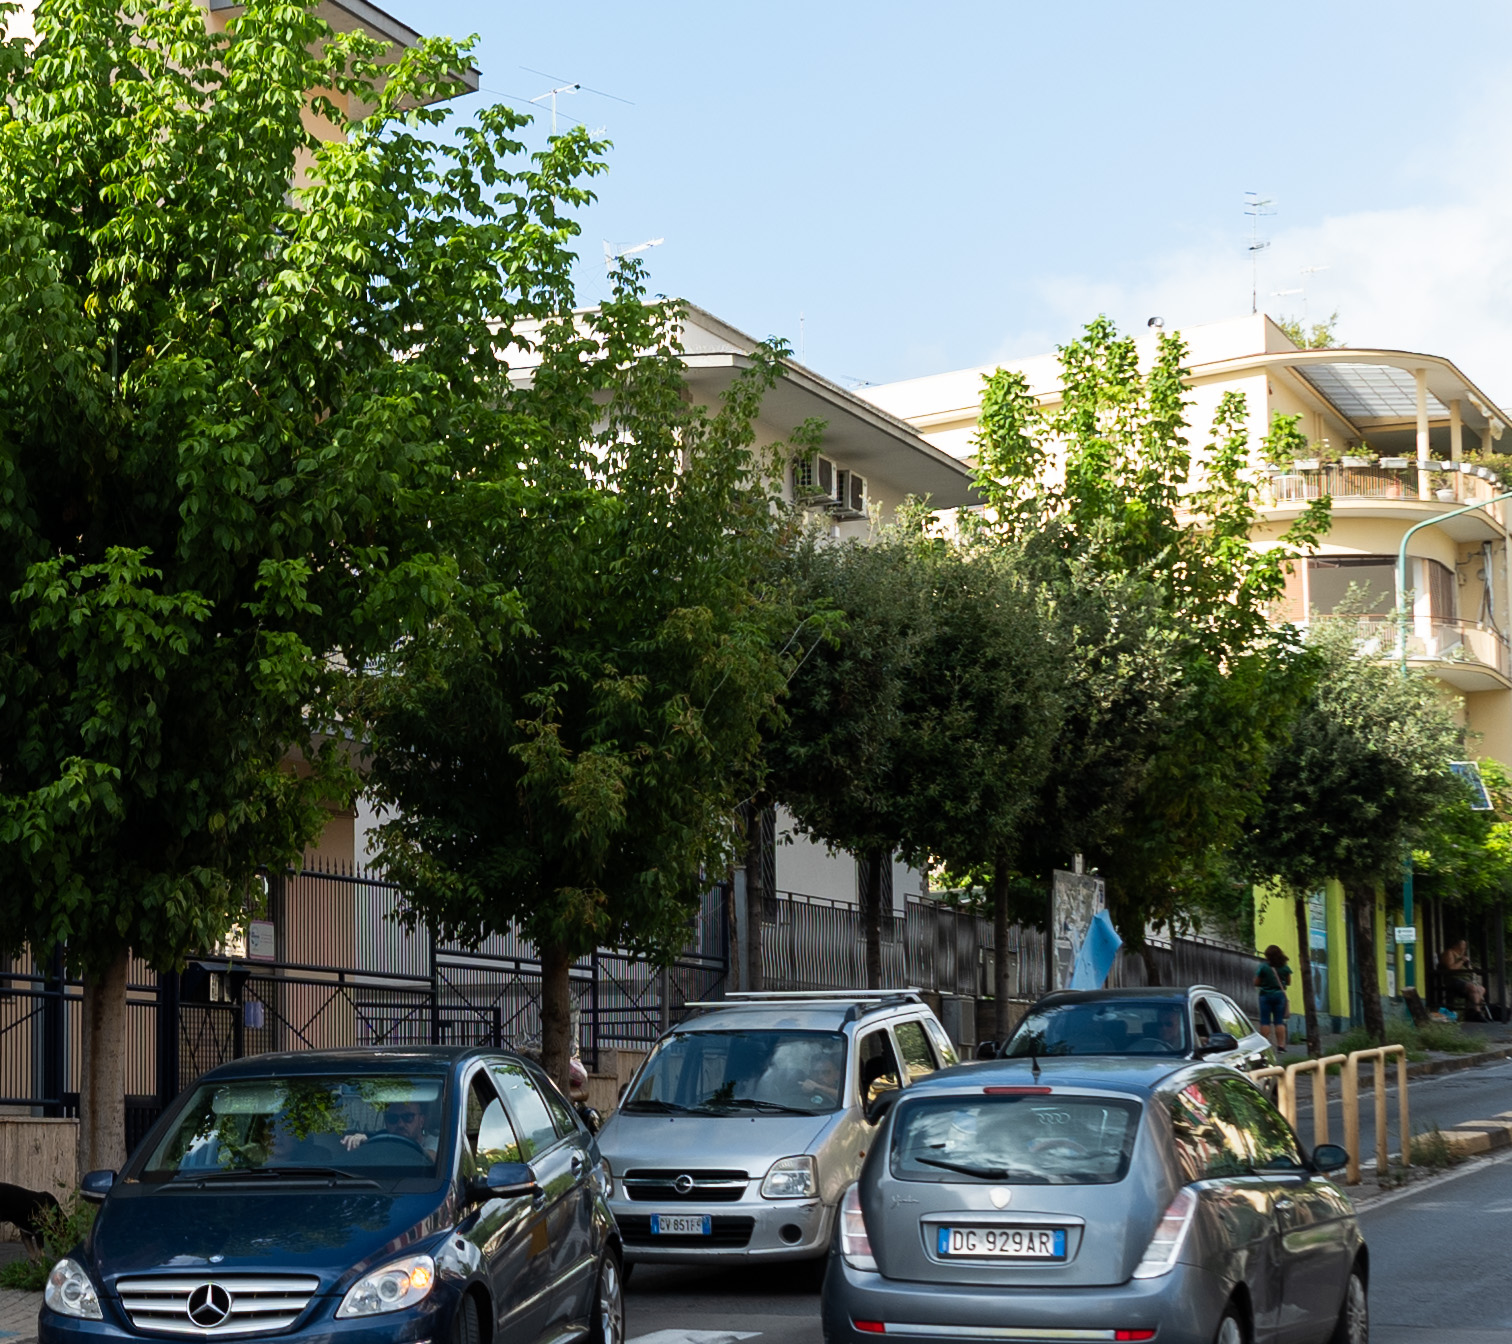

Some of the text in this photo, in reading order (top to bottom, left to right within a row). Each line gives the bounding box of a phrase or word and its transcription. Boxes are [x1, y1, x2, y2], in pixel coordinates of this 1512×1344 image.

[659, 1218, 671, 1231] CV
[953, 1230, 1051, 1253] DG 929AR
